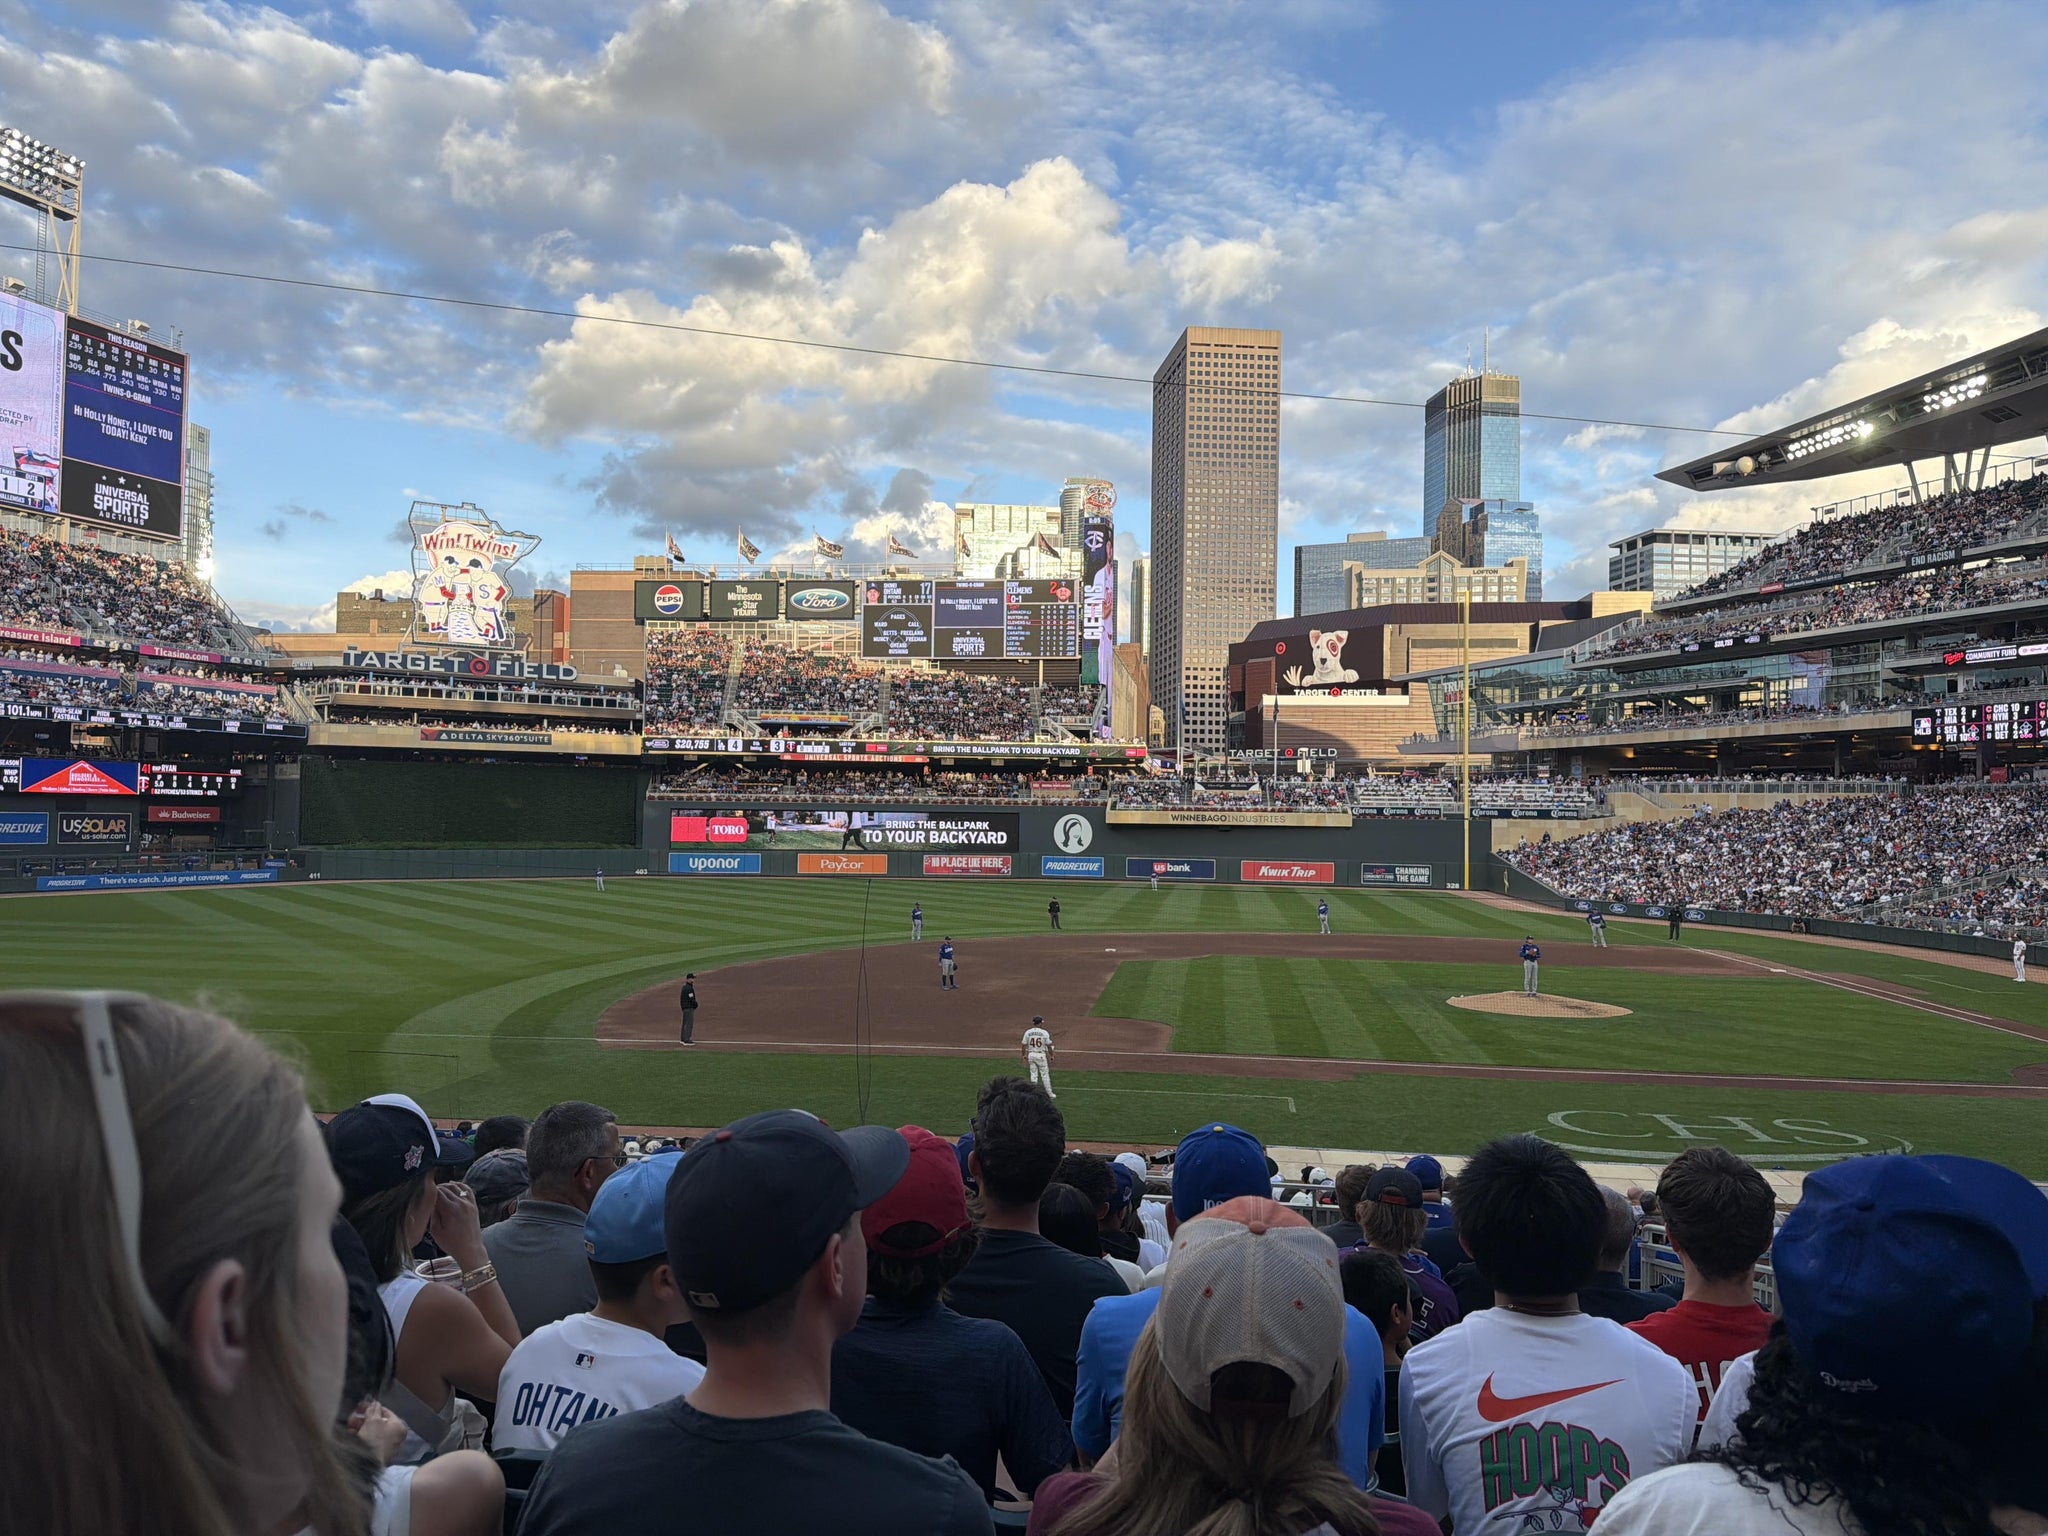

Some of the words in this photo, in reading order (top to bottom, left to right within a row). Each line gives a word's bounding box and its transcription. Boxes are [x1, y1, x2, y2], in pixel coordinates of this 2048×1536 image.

[68, 341, 82, 350] 239
[84, 346, 94, 354] 32
[107, 333, 122, 344] THIS
[123, 337, 147, 353] SEASON
[103, 383, 151, 404] TWINS-O-GRAM
[84, 408, 106, 422] HOLLY
[138, 422, 157, 437] LOVE
[158, 428, 173, 441] YOU
[101, 423, 129, 440] TODAY!
[2, 477, 8, 490] 1
[27, 482, 36, 496] 2
[95, 483, 150, 505] UNIVERSAL
[94, 494, 148, 519] SPORTS
[99, 511, 144, 525] AUCTIONS
[424, 534, 461, 550] Win!
[464, 534, 518, 558] Twins!
[1912, 556, 1925, 566] END
[1927, 550, 1955, 563] RACISM
[920, 582, 930, 594] 17
[1050, 582, 1057, 594] 2
[802, 592, 836, 607] Ford
[42, 634, 72, 645] Island
[1966, 650, 2000, 660] COMMUNITY
[349, 650, 465, 672] TARGET
[496, 660, 578, 680] FIELD
[7, 704, 30, 716] 101.1
[1994, 704, 2008, 712] CHC
[2011, 703, 2019, 711] 10
[1993, 712, 2008, 720] NYM
[1995, 723, 2008, 731] NYY
[451, 733, 483, 741] DELTA
[1995, 731, 2008, 739] DET
[675, 740, 709, 749] $20,755
[732, 741, 738, 749] 4
[775, 741, 780, 750] 3
[1229, 749, 1280, 757] TARGET
[141, 764, 151, 773] 41
[161, 764, 177, 772] RYAN
[172, 810, 211, 819] Budweiser
[1171, 814, 1226, 822] WINNEBAGO
[713, 825, 744, 835] TORO
[886, 820, 915, 829] BRING
[919, 821, 937, 829] THE
[940, 821, 989, 830] BALLPARK
[864, 831, 882, 843] TO
[886, 831, 925, 843] YOUR
[930, 831, 1007, 844] BACKYARD
[689, 858, 740, 870] uponor
[820, 859, 864, 871] Paycor
[941, 858, 967, 867] PLACE
[982, 858, 1003, 868] HERE
[1046, 862, 1100, 871] PROGRESSIVE
[1167, 863, 1190, 872] bank
[47, 879, 87, 887] PROGRESSIVE
[100, 877, 126, 885] There's
[139, 876, 160, 884] catch.
[178, 875, 197, 884] great
[198, 874, 230, 884] coverage.
[240, 872, 271, 880] PROGRESSIVE
[1030, 1038, 1042, 1047] 46
[1547, 1110, 1869, 1146] CHS
[1480, 1421, 1630, 1514] HOOPS
